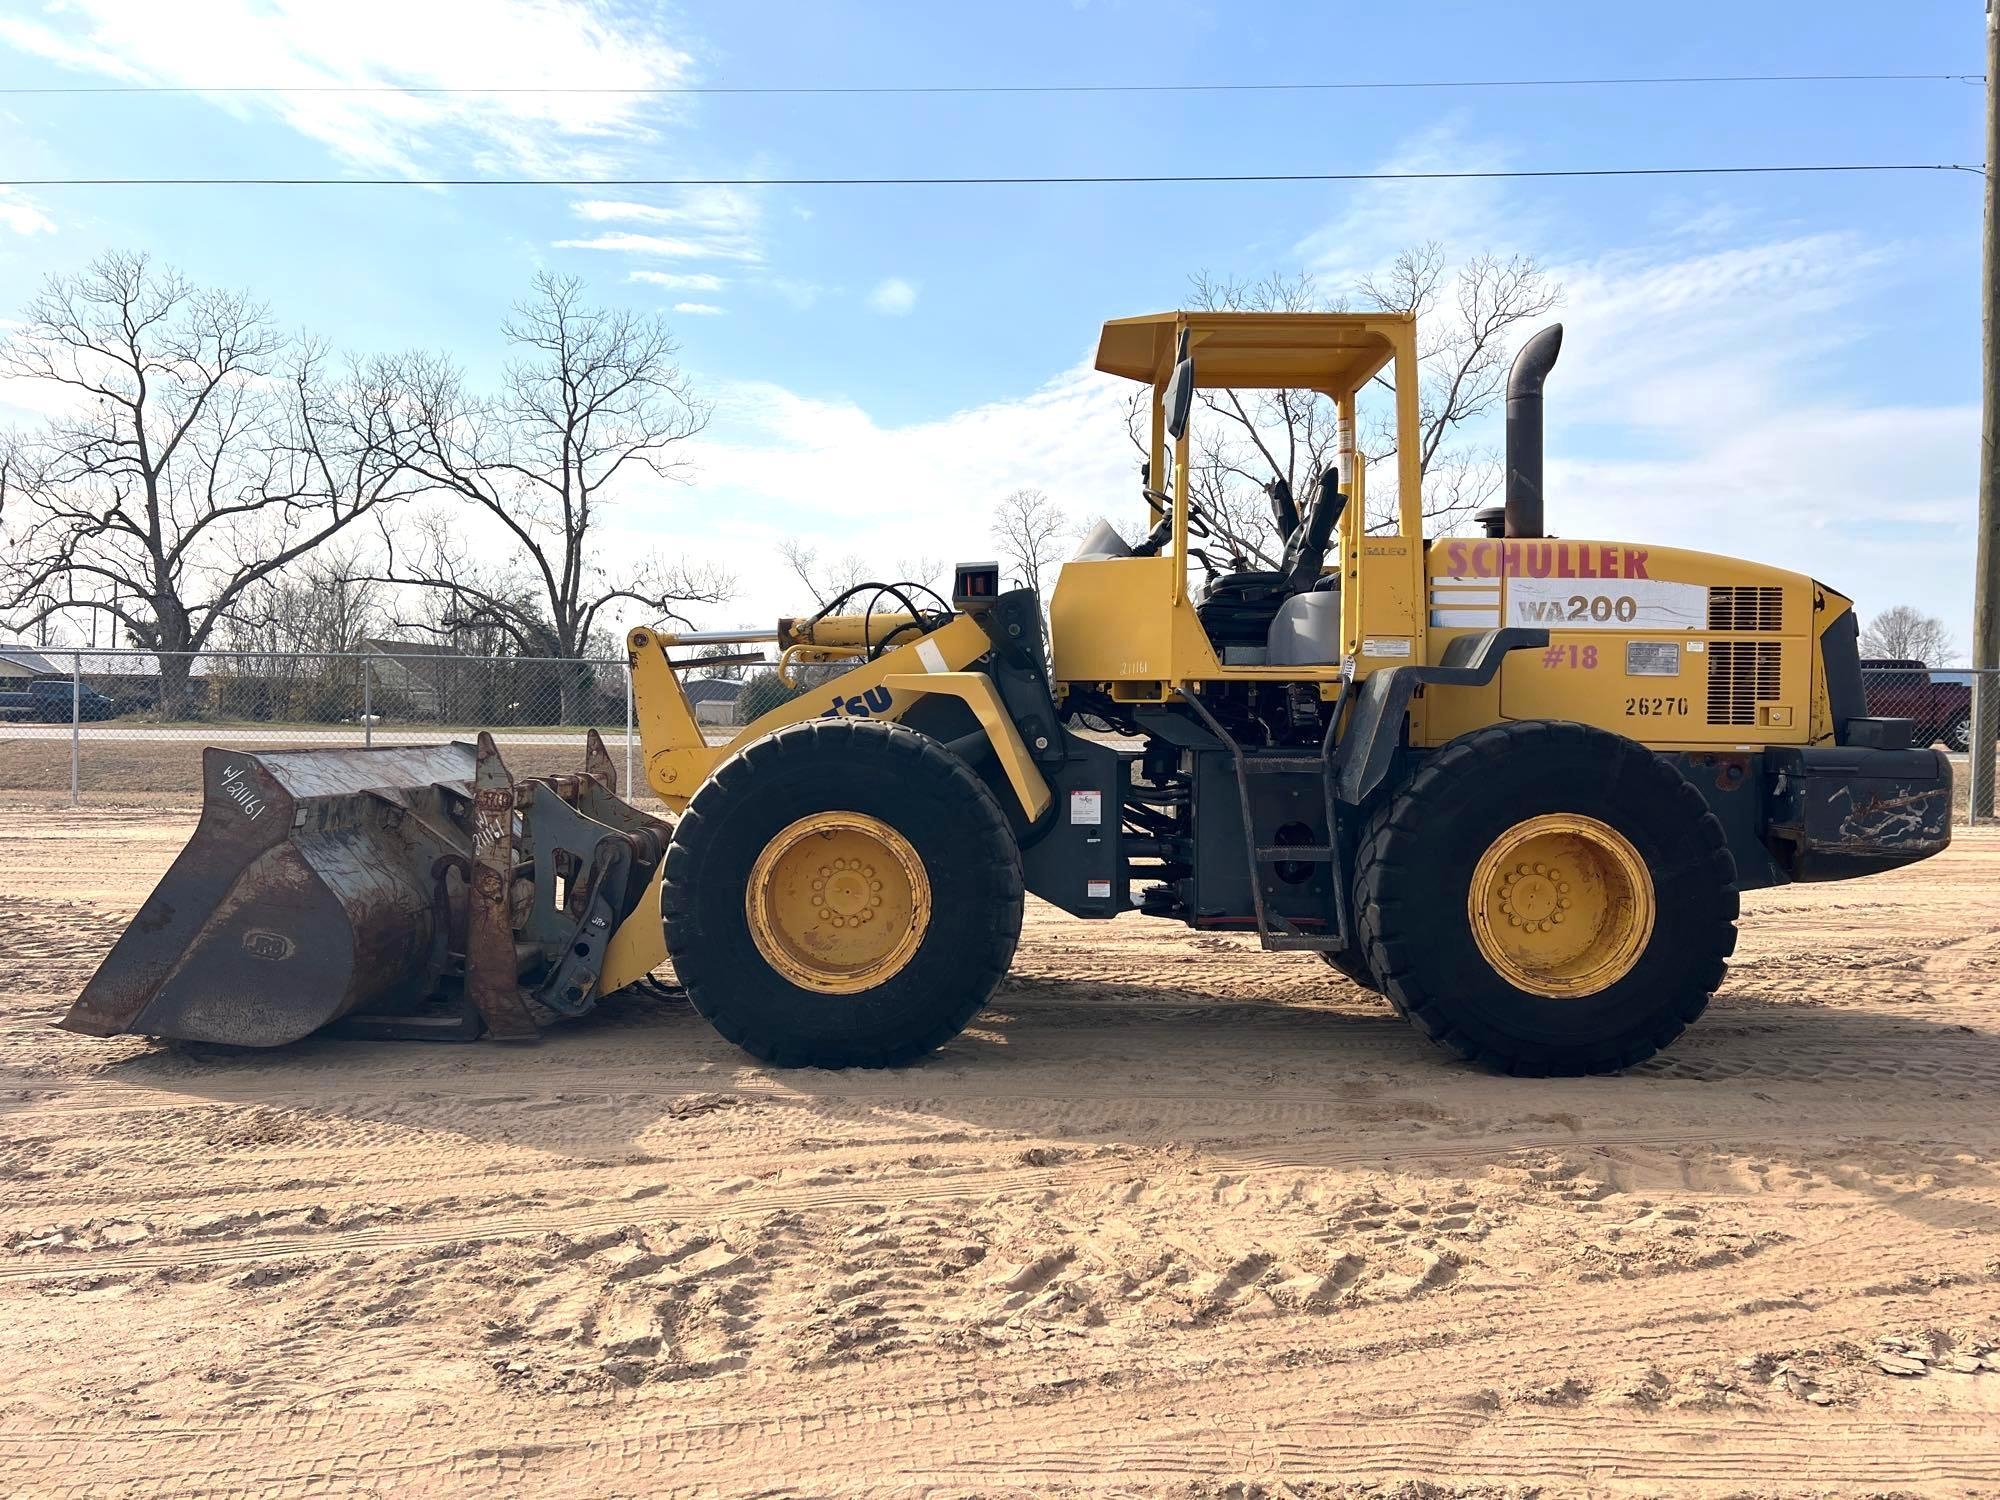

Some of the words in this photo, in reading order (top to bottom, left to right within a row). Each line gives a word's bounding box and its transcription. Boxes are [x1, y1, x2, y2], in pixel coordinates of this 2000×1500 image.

[1447, 541, 1649, 579] SCHULLER
[1518, 595, 1637, 623] WA200
[1542, 644, 1599, 669] #18
